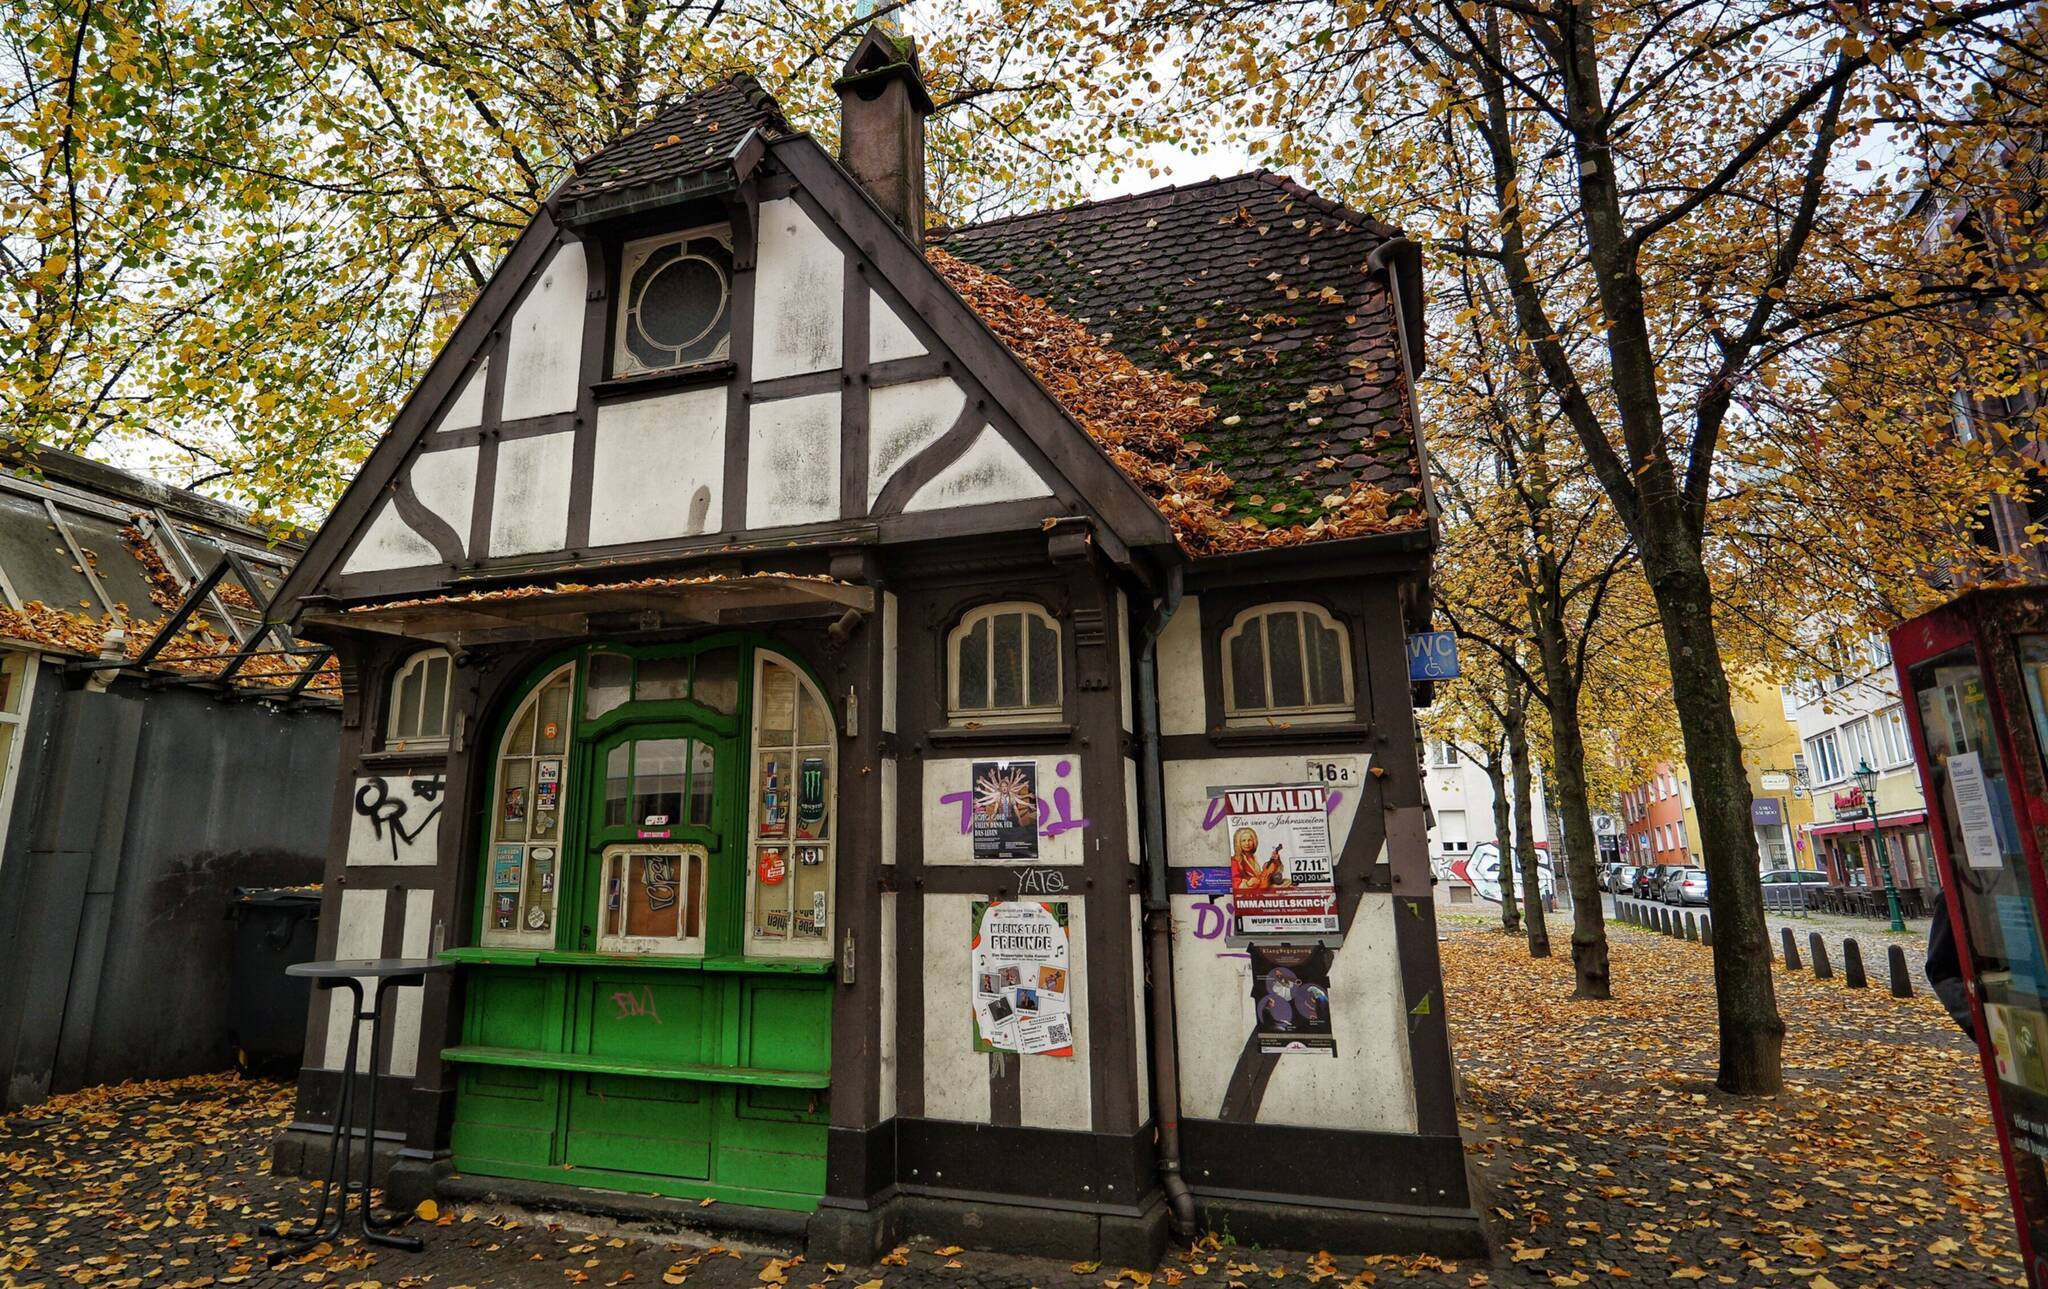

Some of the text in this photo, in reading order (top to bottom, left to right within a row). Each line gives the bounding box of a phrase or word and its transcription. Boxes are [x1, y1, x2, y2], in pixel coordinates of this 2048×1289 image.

[1408, 635, 1452, 657] WC
[1228, 789, 1326, 813] VIVALDI
[1231, 815, 1324, 829] Die vier Jahreszeiten
[1295, 859, 1325, 871] 27.11.
[990, 923, 1052, 934] KLEINSTADT
[991, 935, 1052, 950] FREUNDE
